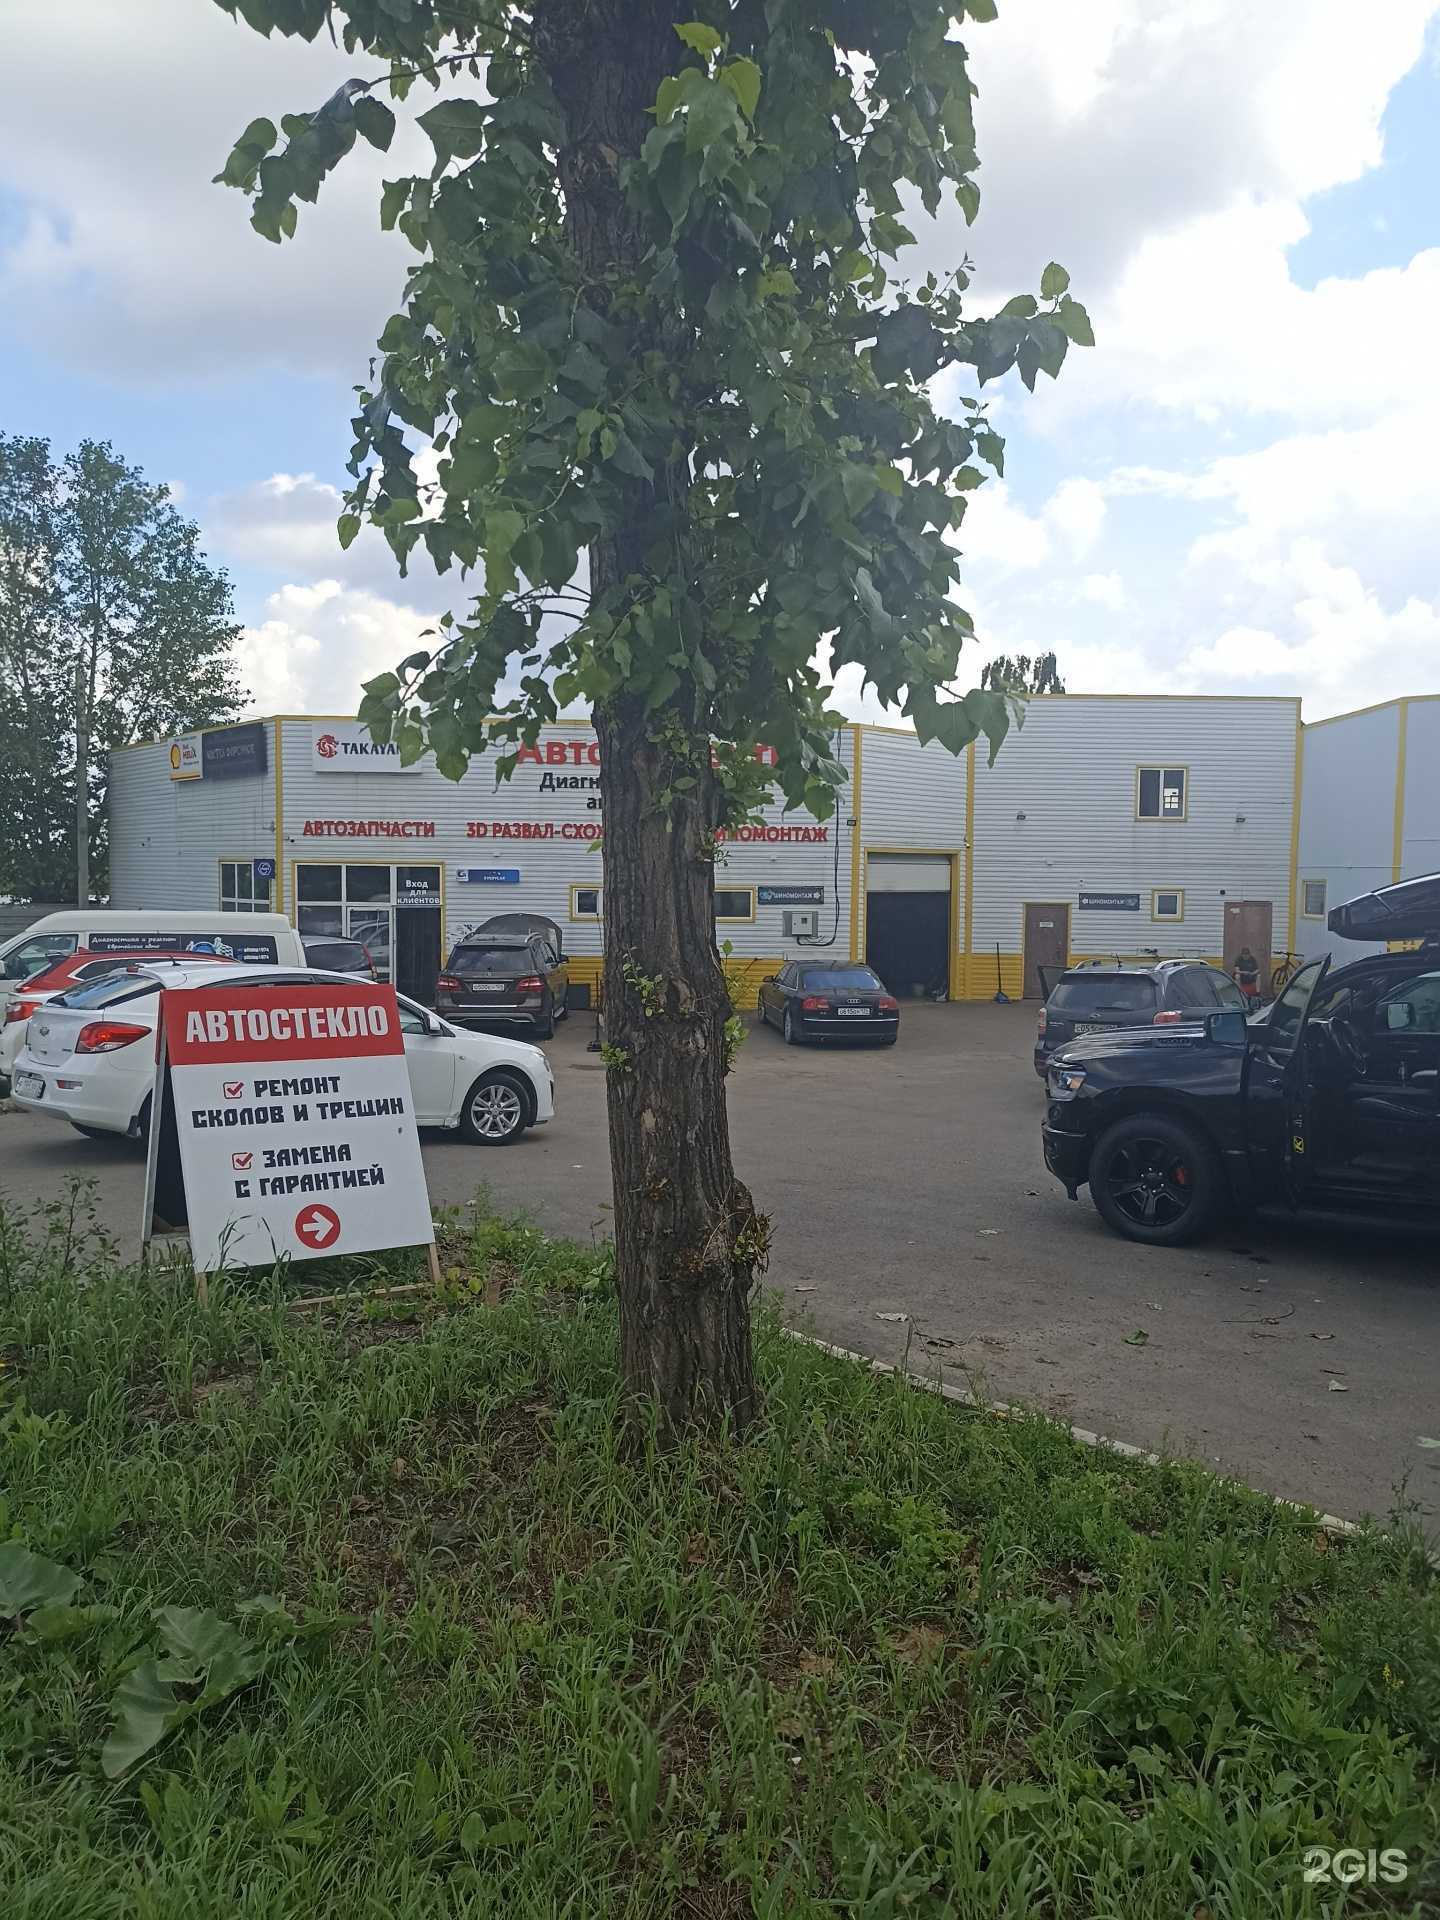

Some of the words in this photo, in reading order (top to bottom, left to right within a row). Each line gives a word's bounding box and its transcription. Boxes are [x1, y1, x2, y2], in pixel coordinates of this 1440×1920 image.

[303, 820, 435, 837] АВТОЗАПЧАСТИ
[467, 822, 487, 837] 3D
[405, 880, 428, 889] Вход
[409, 889, 427, 897] для
[186, 1005, 389, 1043] АВТОСТЕКЛО
[253, 1076, 341, 1098] РЕМОНТ
[191, 1106, 285, 1129] СКОЛОВ
[293, 1104, 309, 1122] И
[316, 1097, 405, 1120] ТРЕЩИН
[262, 1143, 352, 1168] ЗАМЕНА
[234, 1179, 251, 1199] С
[259, 1163, 385, 1197] ГАРАНТИЕЙ
